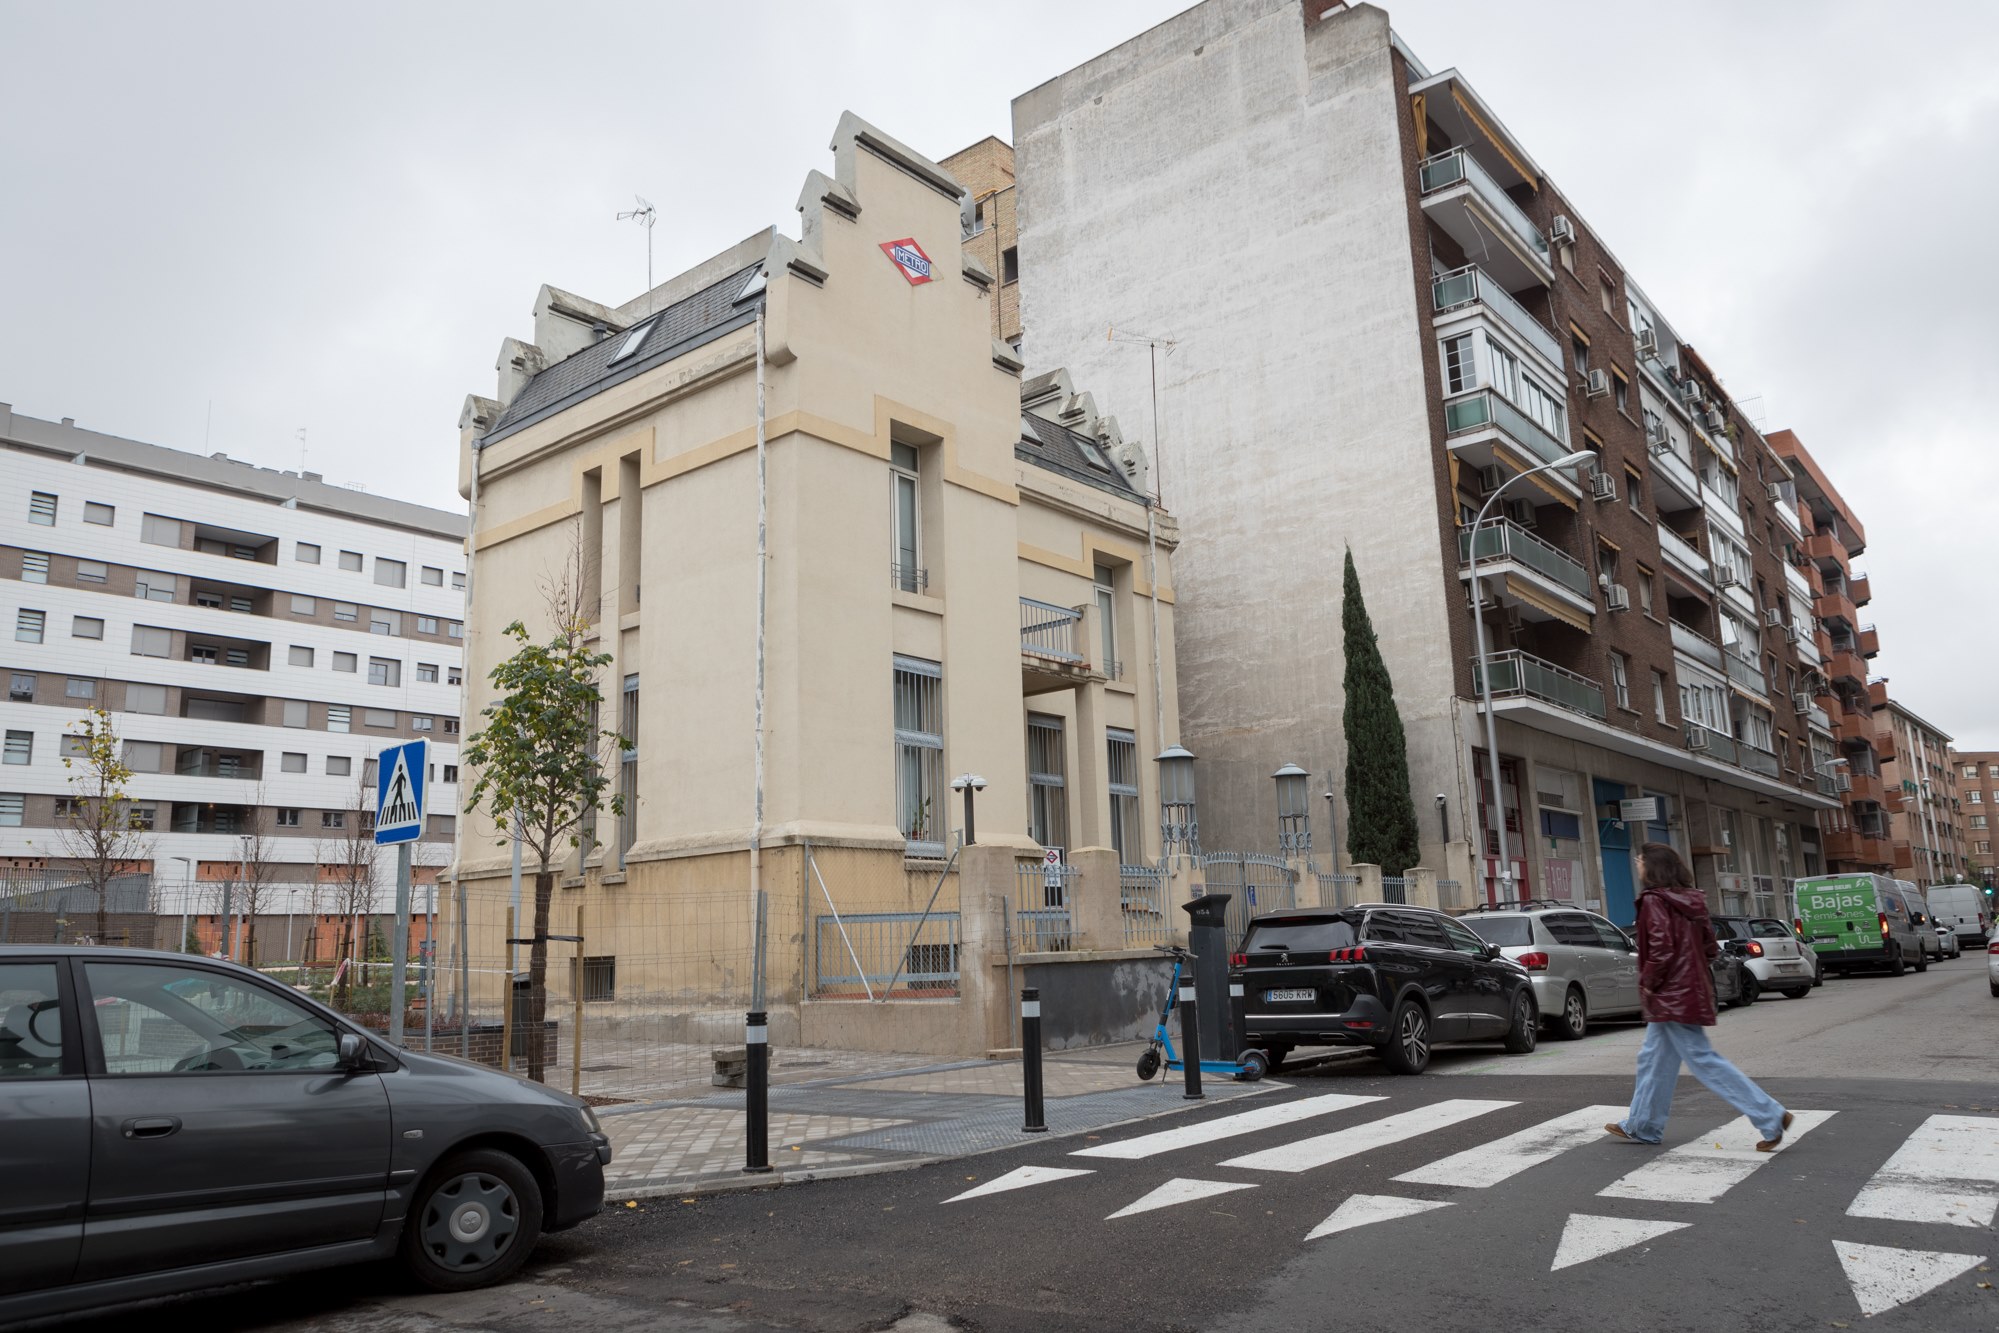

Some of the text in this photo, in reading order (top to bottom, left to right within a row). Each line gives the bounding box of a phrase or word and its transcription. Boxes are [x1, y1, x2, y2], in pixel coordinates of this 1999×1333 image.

[898, 249, 927, 273] METRO
[1811, 893, 1864, 911] Bajas
[1813, 910, 1865, 920] emisones
[1273, 989, 1313, 1000] 5605 KRW
